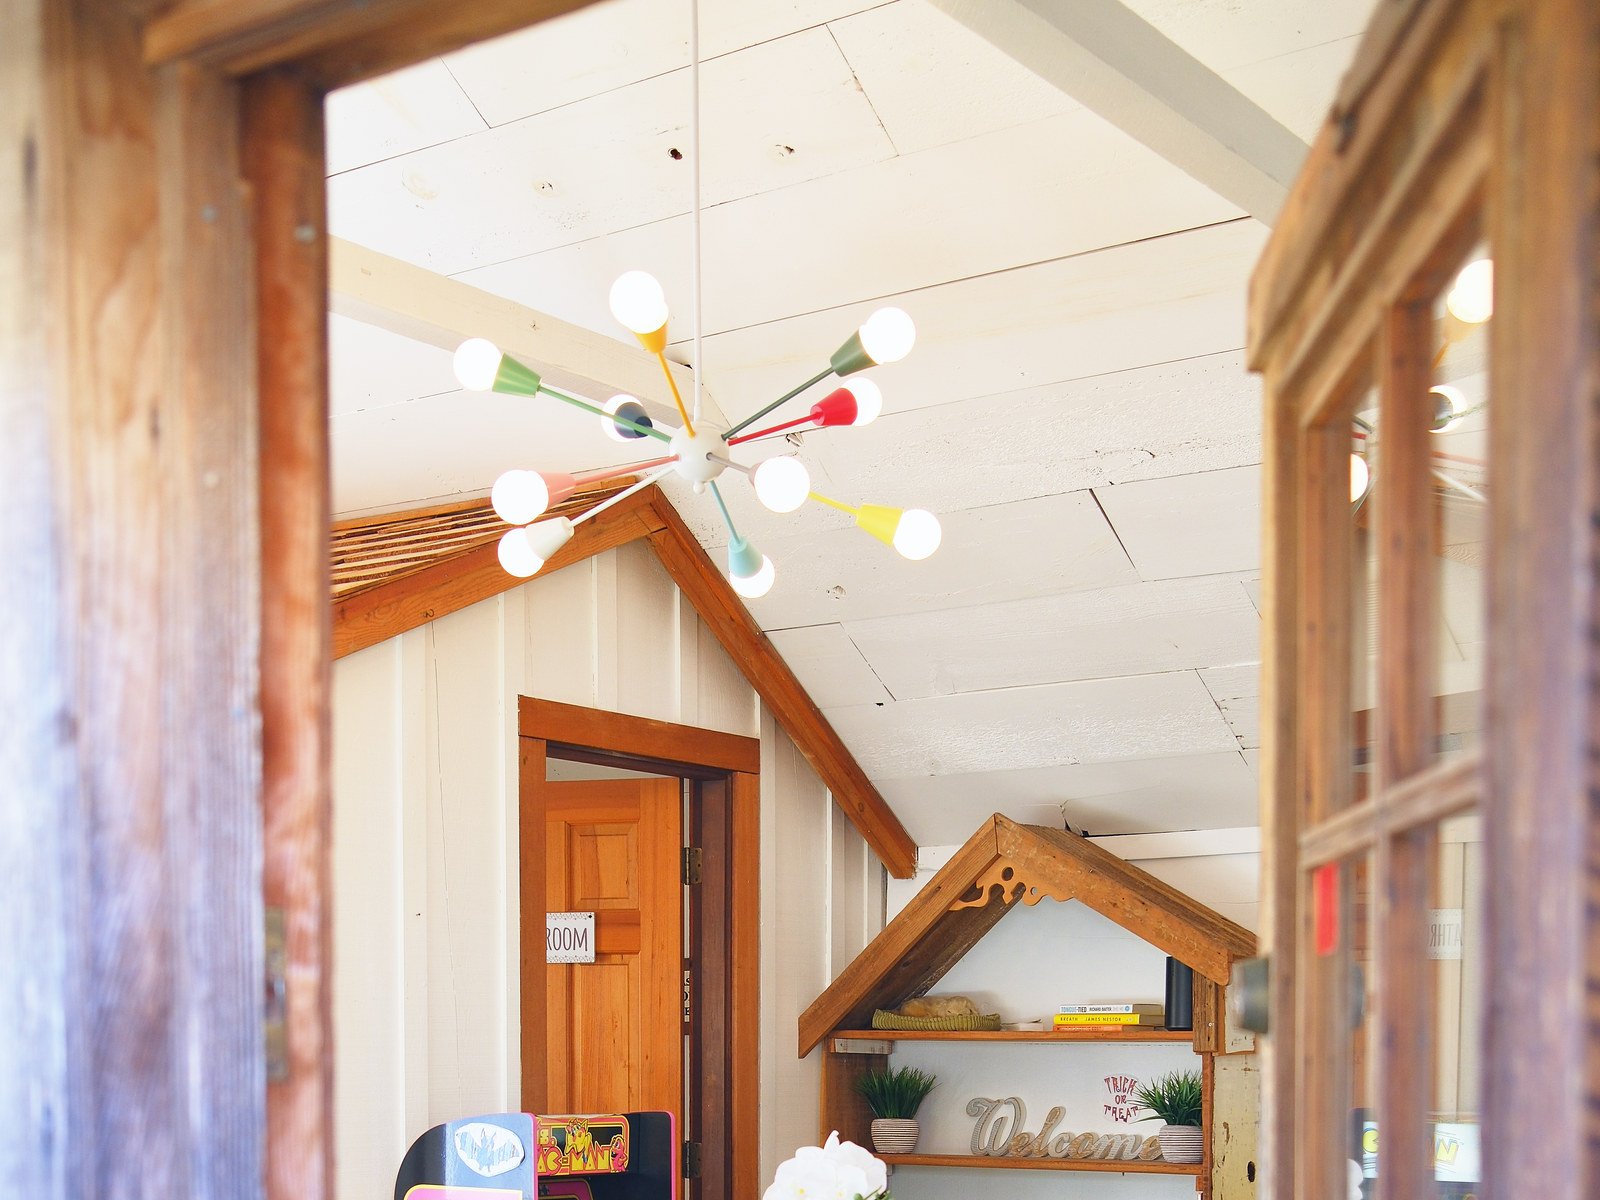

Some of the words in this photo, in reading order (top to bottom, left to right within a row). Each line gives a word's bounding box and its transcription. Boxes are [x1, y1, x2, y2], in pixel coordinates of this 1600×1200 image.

[1104, 1076, 1137, 1096] TRICK
[1115, 1095, 1127, 1105] OR
[1104, 1104, 1139, 1122] TREAT
[966, 1096, 1163, 1160] Welcome
[537, 1142, 611, 1173] AC-MAN
